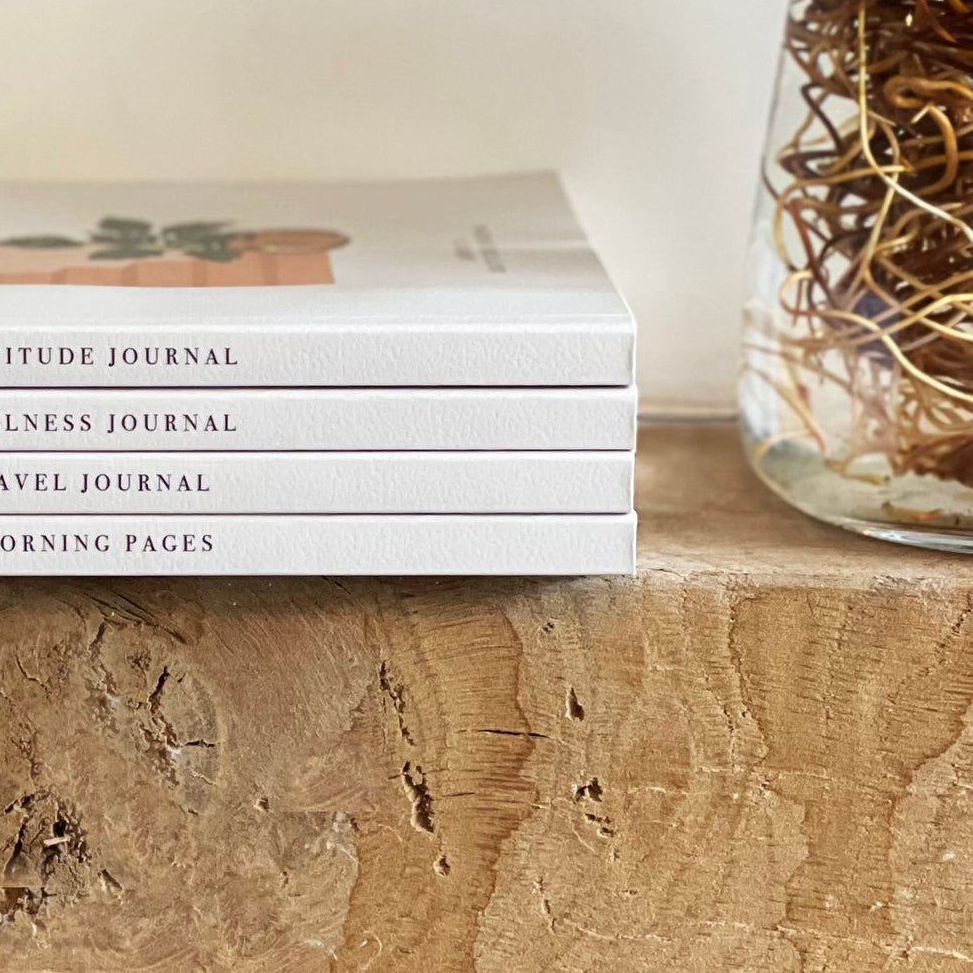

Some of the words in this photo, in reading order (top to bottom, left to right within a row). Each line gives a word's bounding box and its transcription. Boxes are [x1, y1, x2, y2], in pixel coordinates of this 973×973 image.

[108, 346, 238, 367] JOURNAL
[106, 413, 237, 433] JOURNAL
[80, 472, 210, 493] JOURNAL
[125, 534, 213, 552] PAGES
